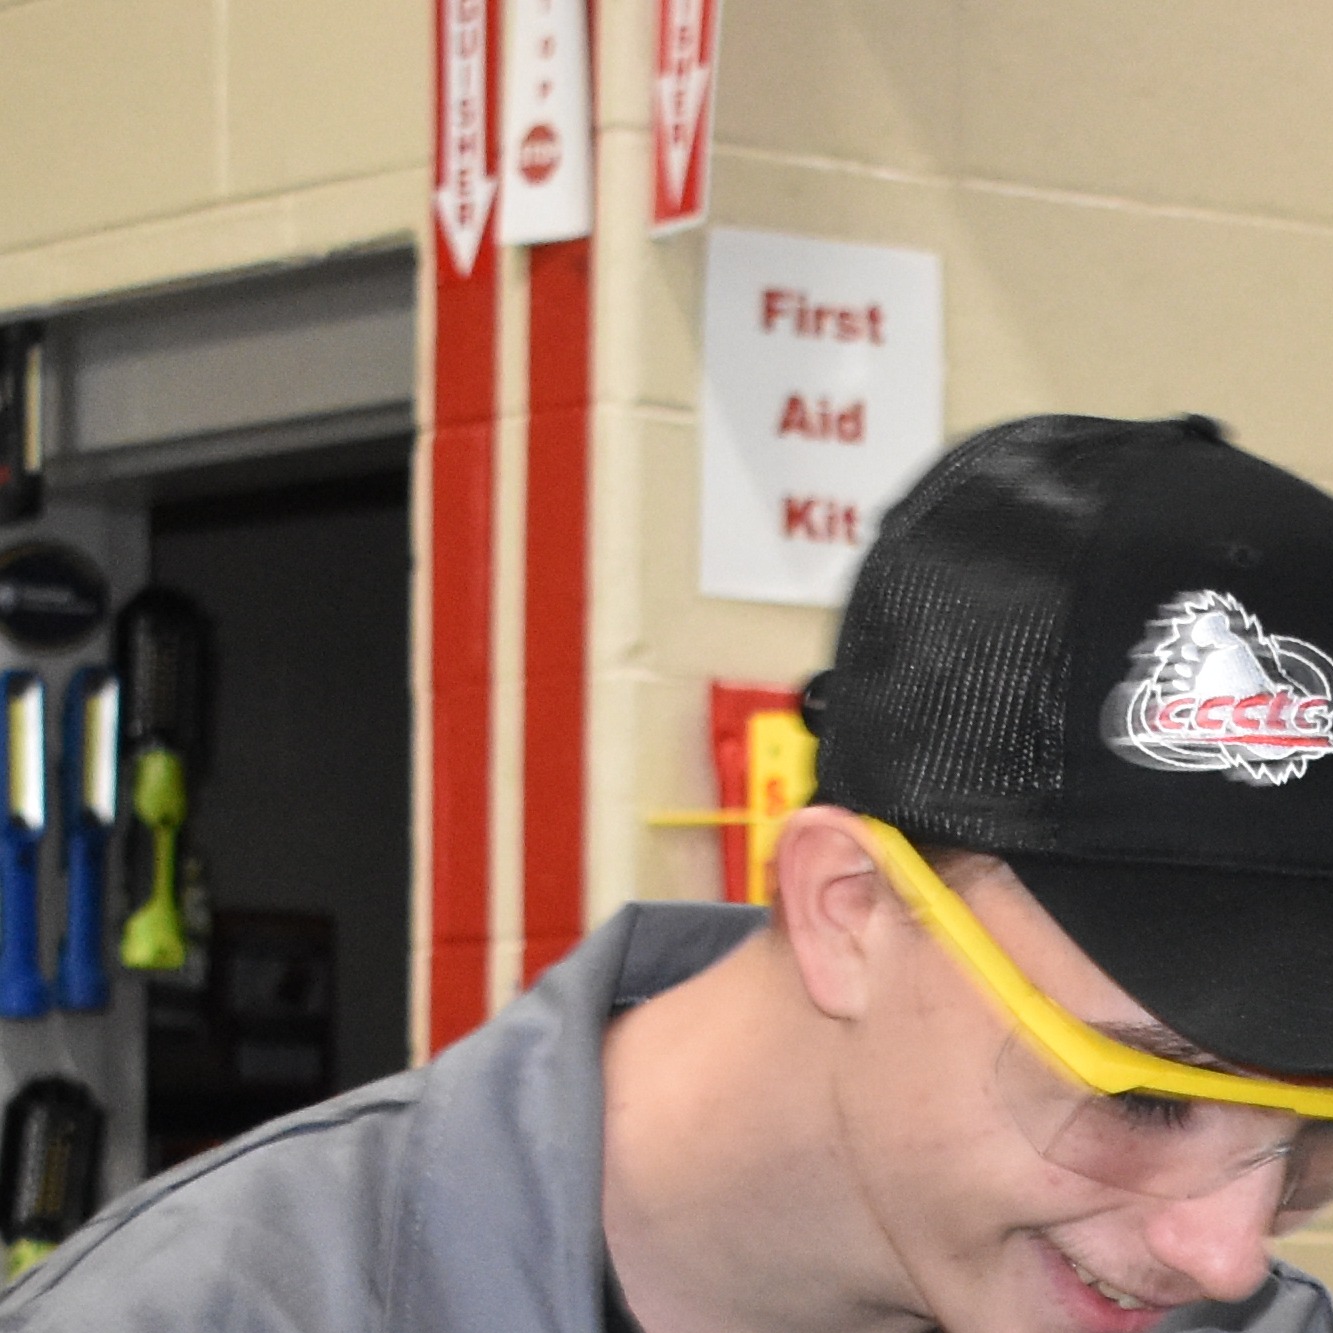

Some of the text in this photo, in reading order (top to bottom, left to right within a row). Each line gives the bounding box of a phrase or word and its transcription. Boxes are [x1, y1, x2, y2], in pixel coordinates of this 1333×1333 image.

[760, 286, 884, 346] First
[777, 392, 866, 443] Aid
[782, 498, 858, 547] Kit
